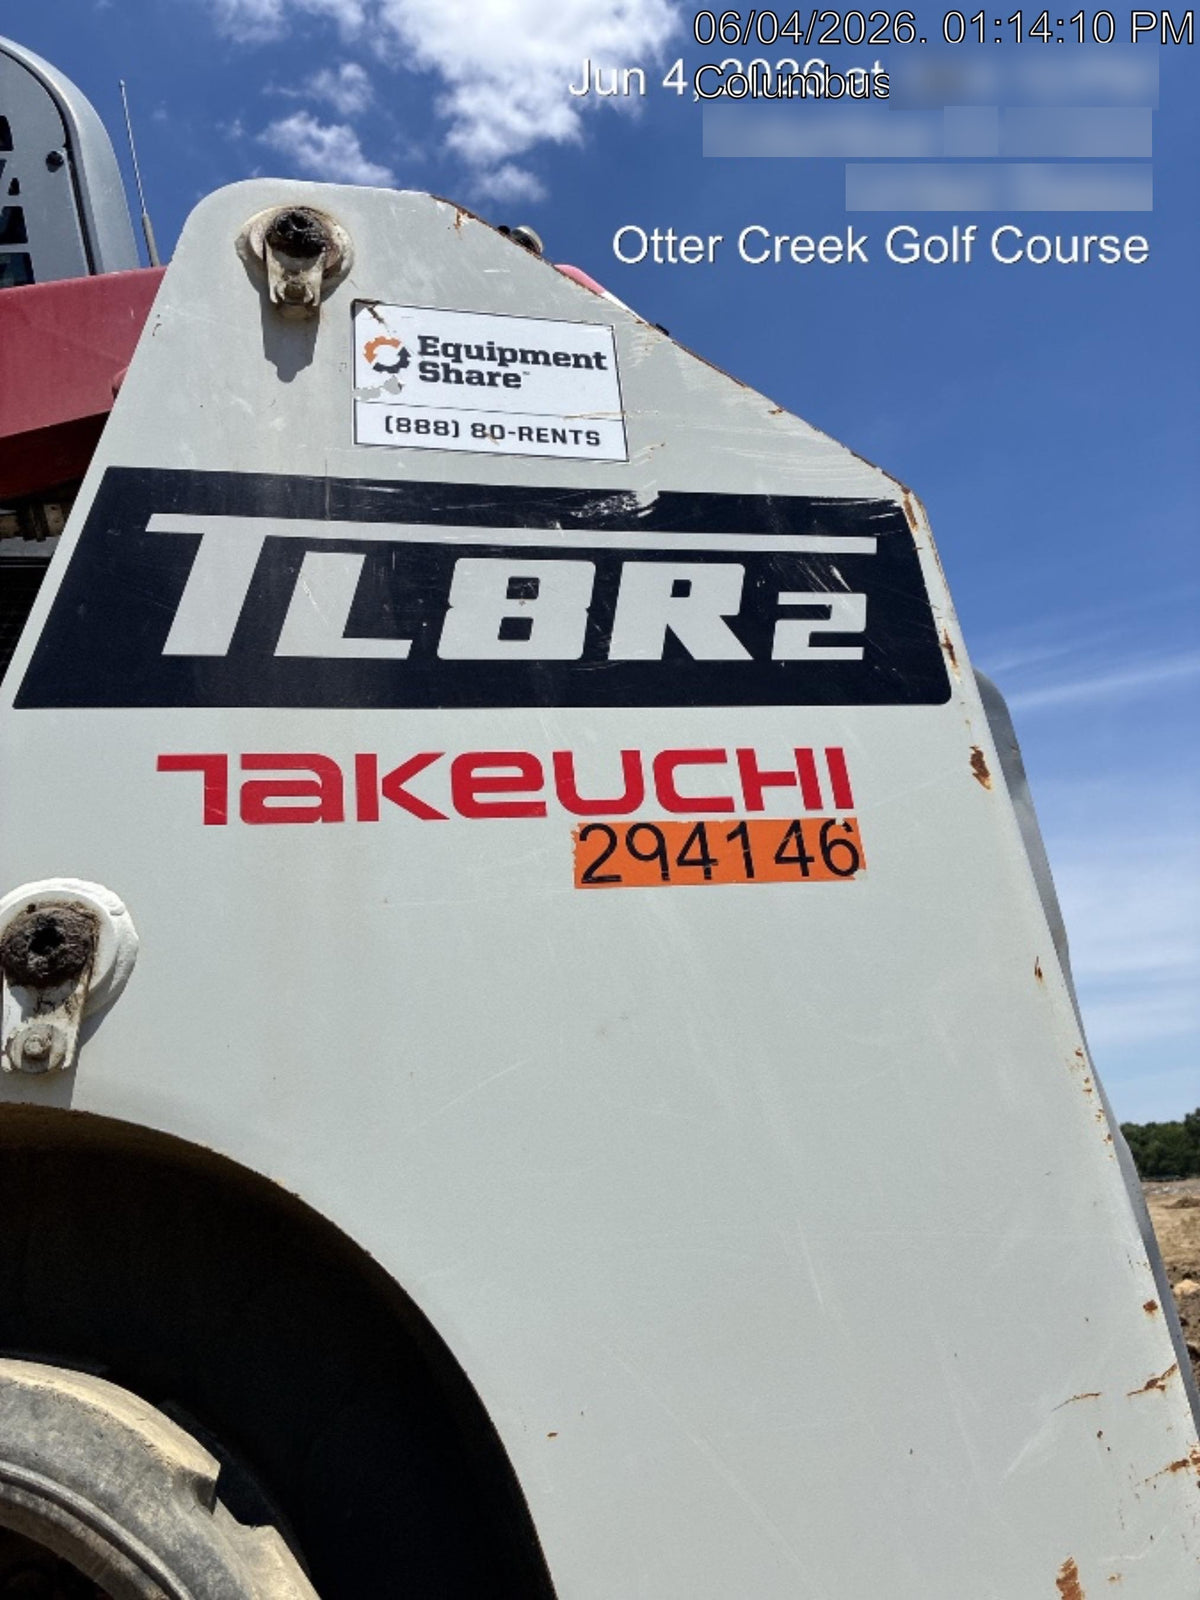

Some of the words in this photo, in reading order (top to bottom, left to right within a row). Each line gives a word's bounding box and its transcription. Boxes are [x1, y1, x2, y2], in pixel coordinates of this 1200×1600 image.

[417, 335, 608, 371] Equipment
[385, 415, 460, 438] (888)
[471, 423, 601, 446] 80-RENTS
[579, 818, 860, 884] 294146
